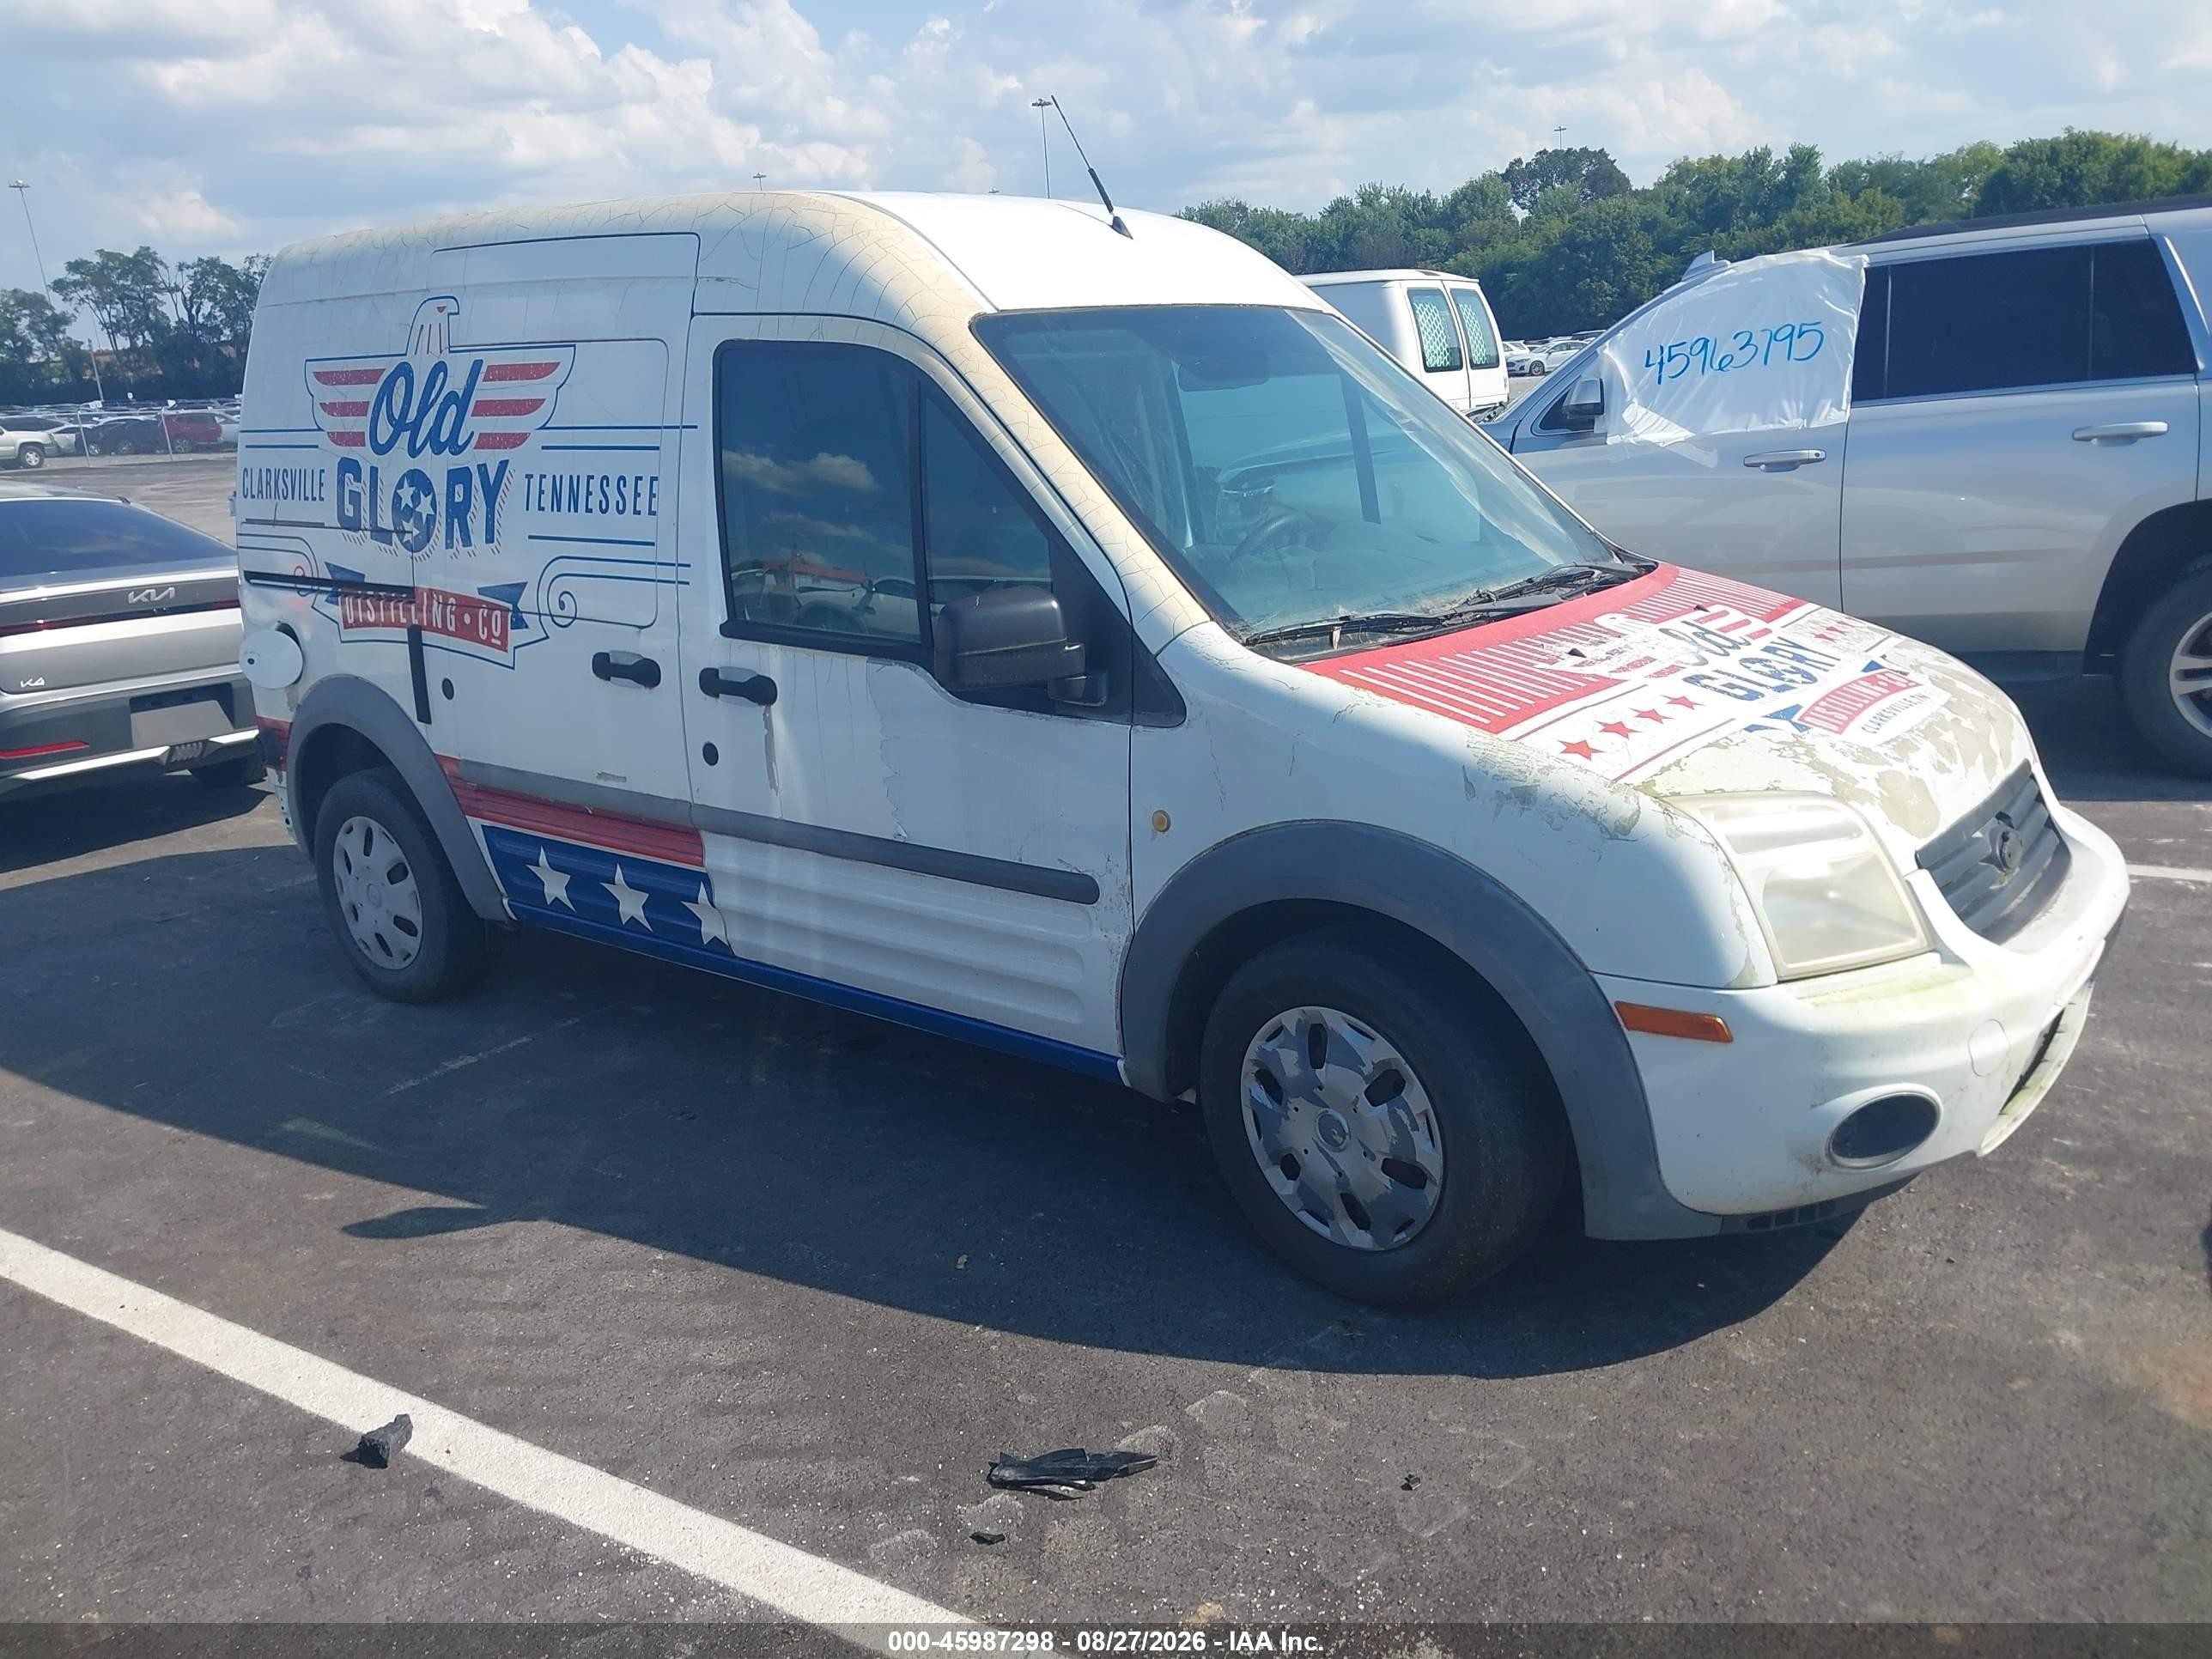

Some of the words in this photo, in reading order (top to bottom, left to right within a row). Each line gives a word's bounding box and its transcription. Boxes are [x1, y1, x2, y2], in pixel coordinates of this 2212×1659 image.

[1644, 321, 1825, 386] 45963795
[369, 359, 483, 458] Old
[242, 466, 325, 503] CLARKSVILLE
[337, 457, 512, 555] GLORY
[525, 473, 659, 516] TENNESSEE
[344, 591, 456, 632] DISTILLING
[1682, 636, 1841, 702] GLORY
